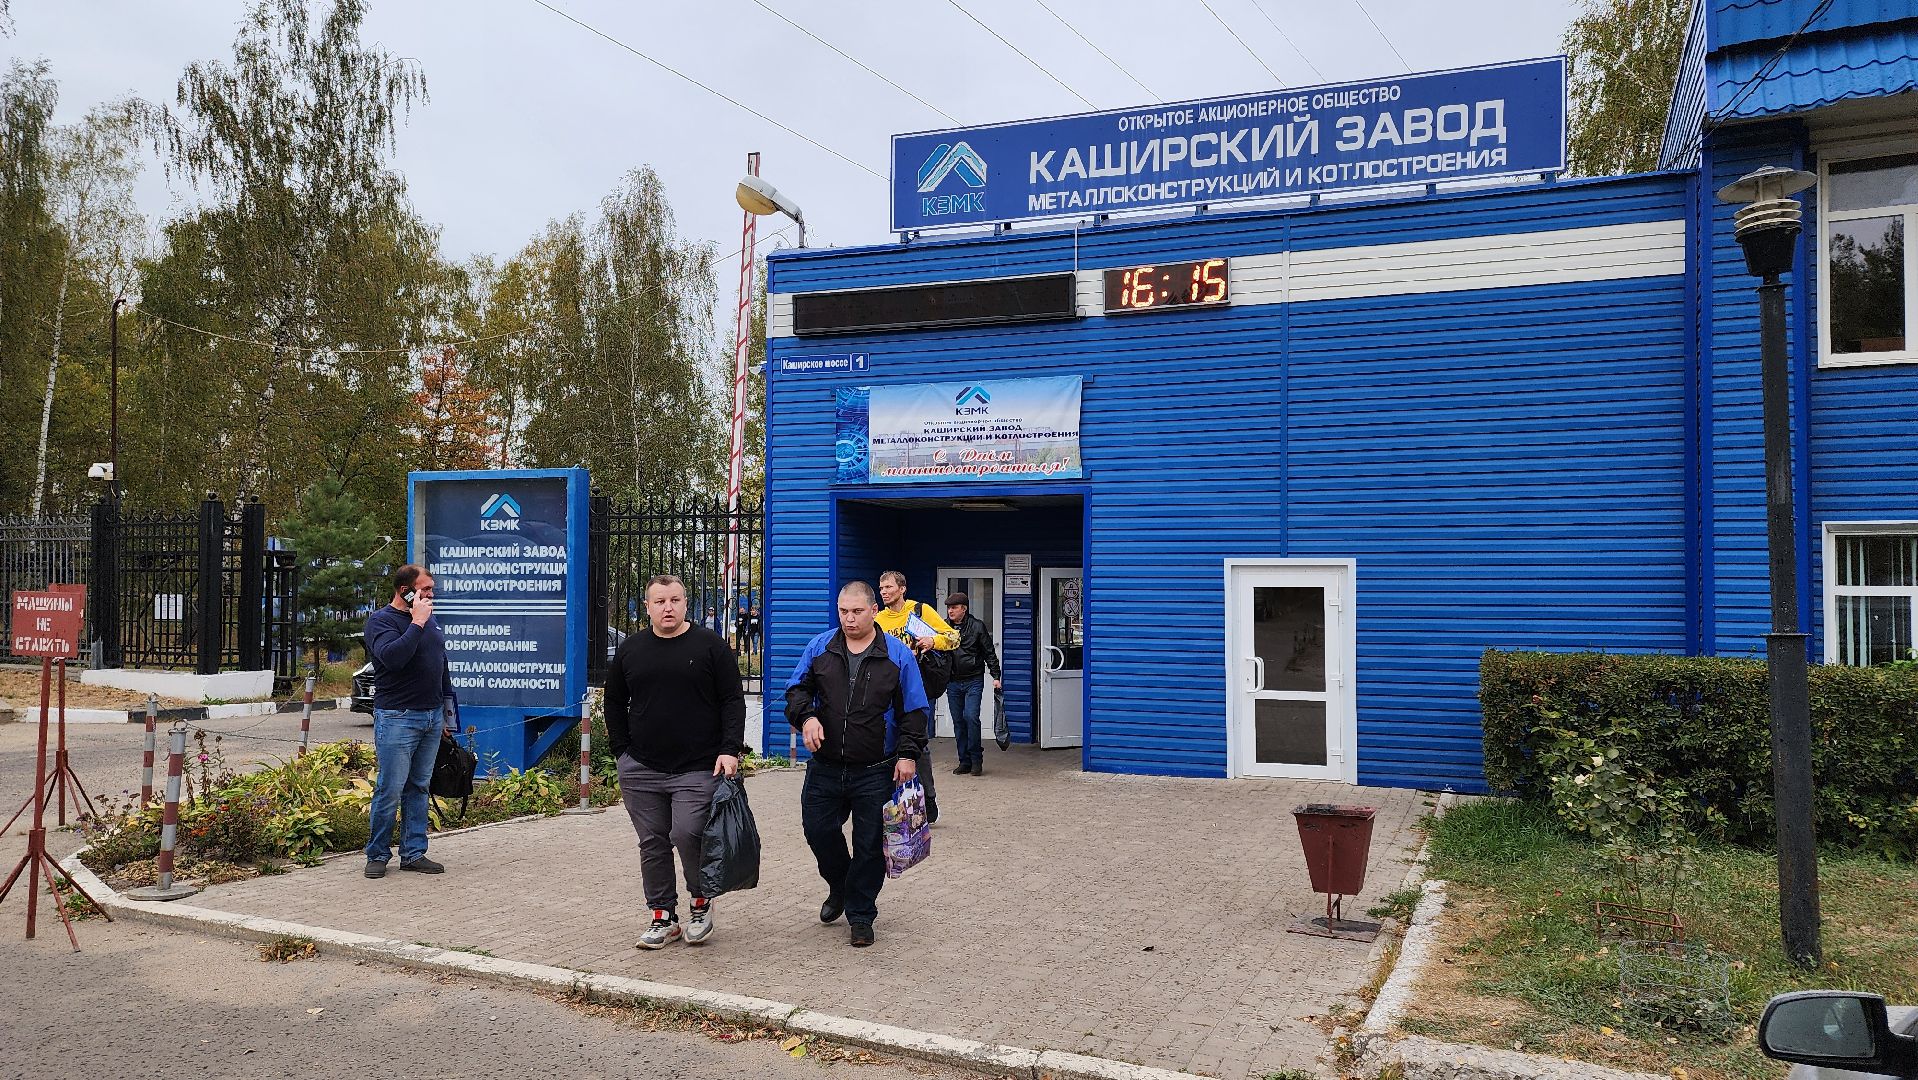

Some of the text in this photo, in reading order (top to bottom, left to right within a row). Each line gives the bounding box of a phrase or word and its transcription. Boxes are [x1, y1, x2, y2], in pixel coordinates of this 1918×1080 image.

[1118, 85, 1401, 132] ОТКРЫТОЕ АКЦИОНЕРНОЕ ОБЩЕСТВО
[1029, 99, 1507, 184] КАШИРСКИЙ ЗАВОД
[1028, 147, 1507, 212] МЕТАЛЛОКОНСТРУКЦИЙ И КОТЛОСТРОЕНИЯ
[783, 355, 864, 371] Каширское шоссе 1
[924, 424, 1023, 434] КАШИРСКИЙ ЗАВОД
[995, 431, 1079, 441] КОТЛОСТРОЕНИЯ
[440, 542, 567, 559] КАШИРСКИЙ ЗАВОД
[443, 580, 562, 592] И КОТЛОСТРОЕНИЯ
[36, 617, 52, 632] НЕ
[444, 625, 511, 636] КОТЕЛЬНОЕ
[15, 636, 70, 653] СТАВИТЬ
[444, 640, 538, 652] ОБОРУДОВАНИЕ
[450, 674, 560, 690] ЮБОЙ СЛОЖНОСТИ
